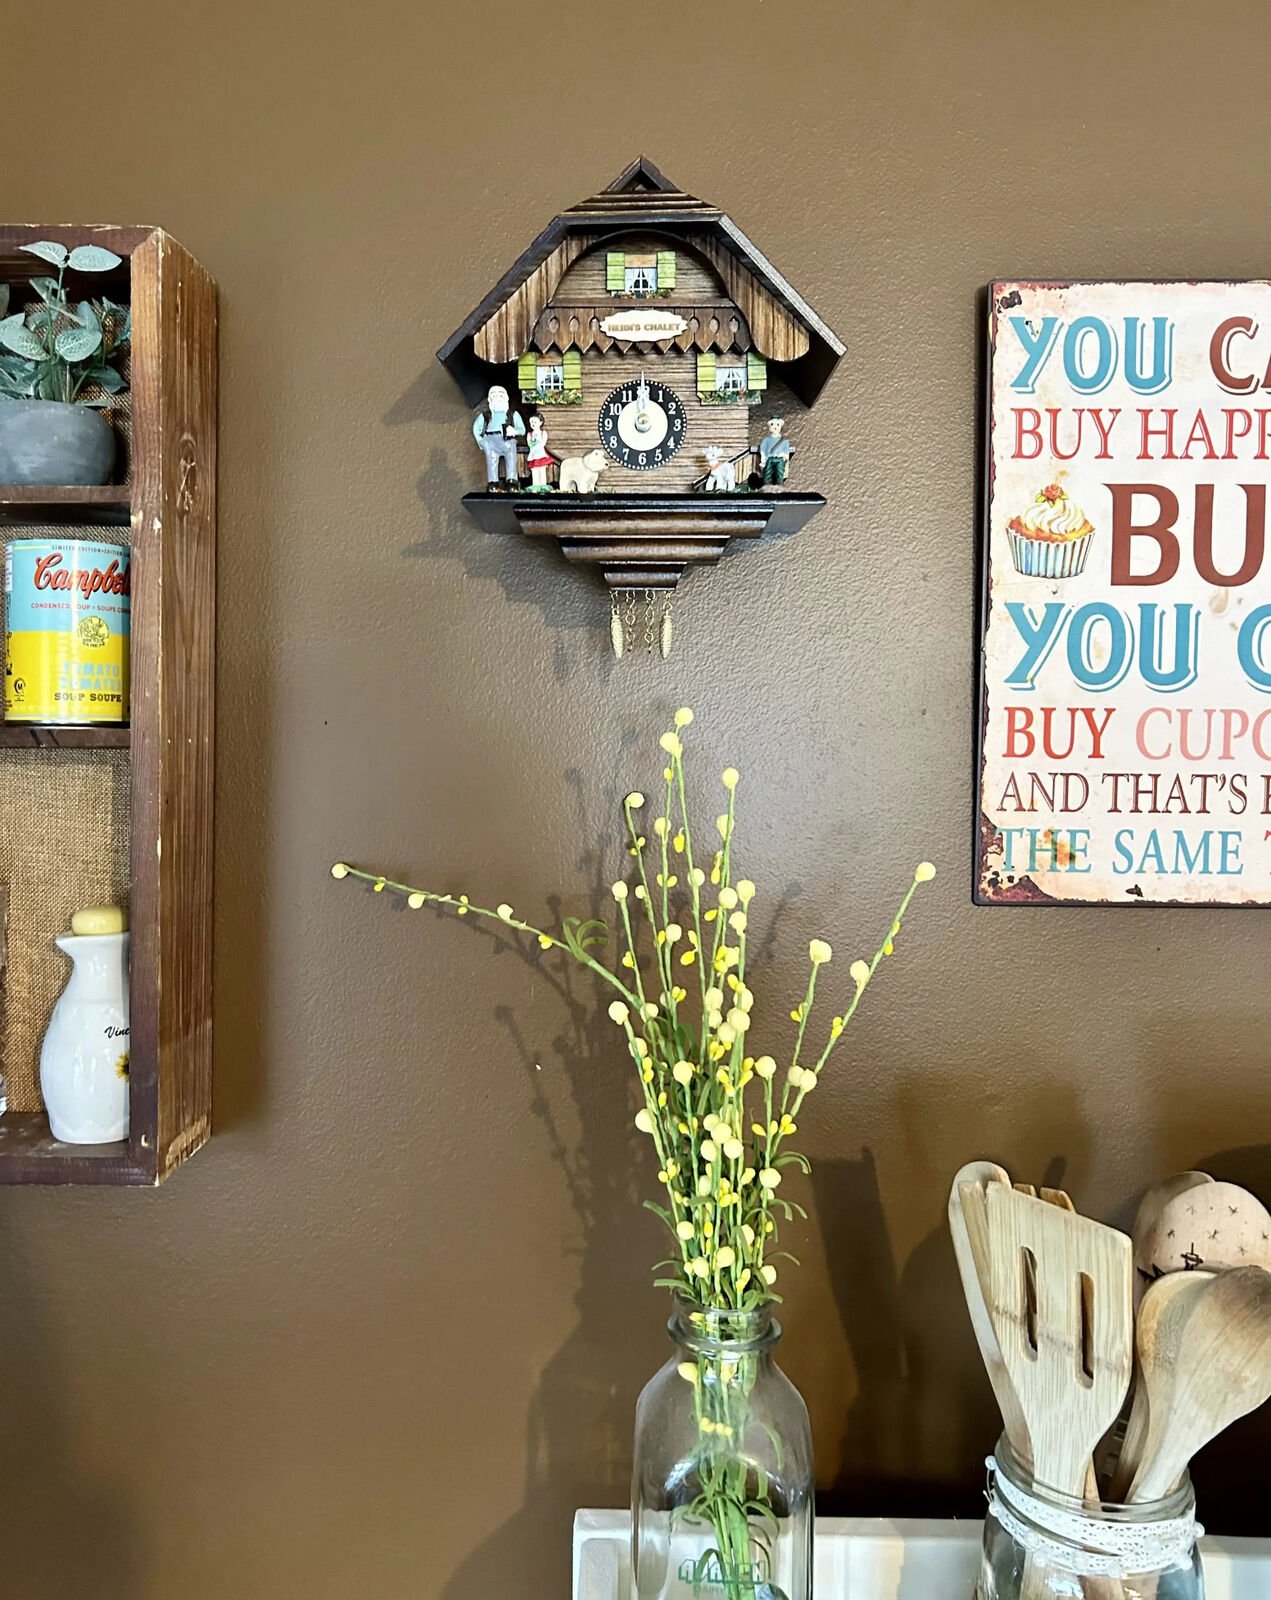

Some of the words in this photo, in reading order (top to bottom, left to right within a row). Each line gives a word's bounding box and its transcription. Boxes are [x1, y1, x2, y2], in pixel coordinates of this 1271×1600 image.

[608, 323, 641, 332] HEIDI'S
[644, 323, 681, 332] CHALET
[1008, 316, 1175, 396] YOU
[1209, 316, 1271, 396] C
[621, 390, 632, 402] 11
[657, 389, 664, 402] 1
[609, 403, 622, 415] 10
[667, 402, 676, 415] 2
[604, 418, 613, 431] 9
[673, 418, 682, 431] 3
[1010, 408, 1122, 460] BUY
[609, 435, 617, 448] 8
[667, 436, 675, 449] 4
[622, 448, 629, 460] 7
[638, 452, 647, 465] 6
[654, 448, 663, 461] 5
[1004, 602, 1202, 693] YOU
[54, 692, 85, 701] SOUP
[90, 693, 122, 703] SOUPE
[1002, 706, 1116, 760] BUY
[996, 771, 1090, 813] AND
[1101, 773, 1248, 815] THAT'S
[996, 827, 1092, 874] THE
[1112, 829, 1244, 875] SAME
